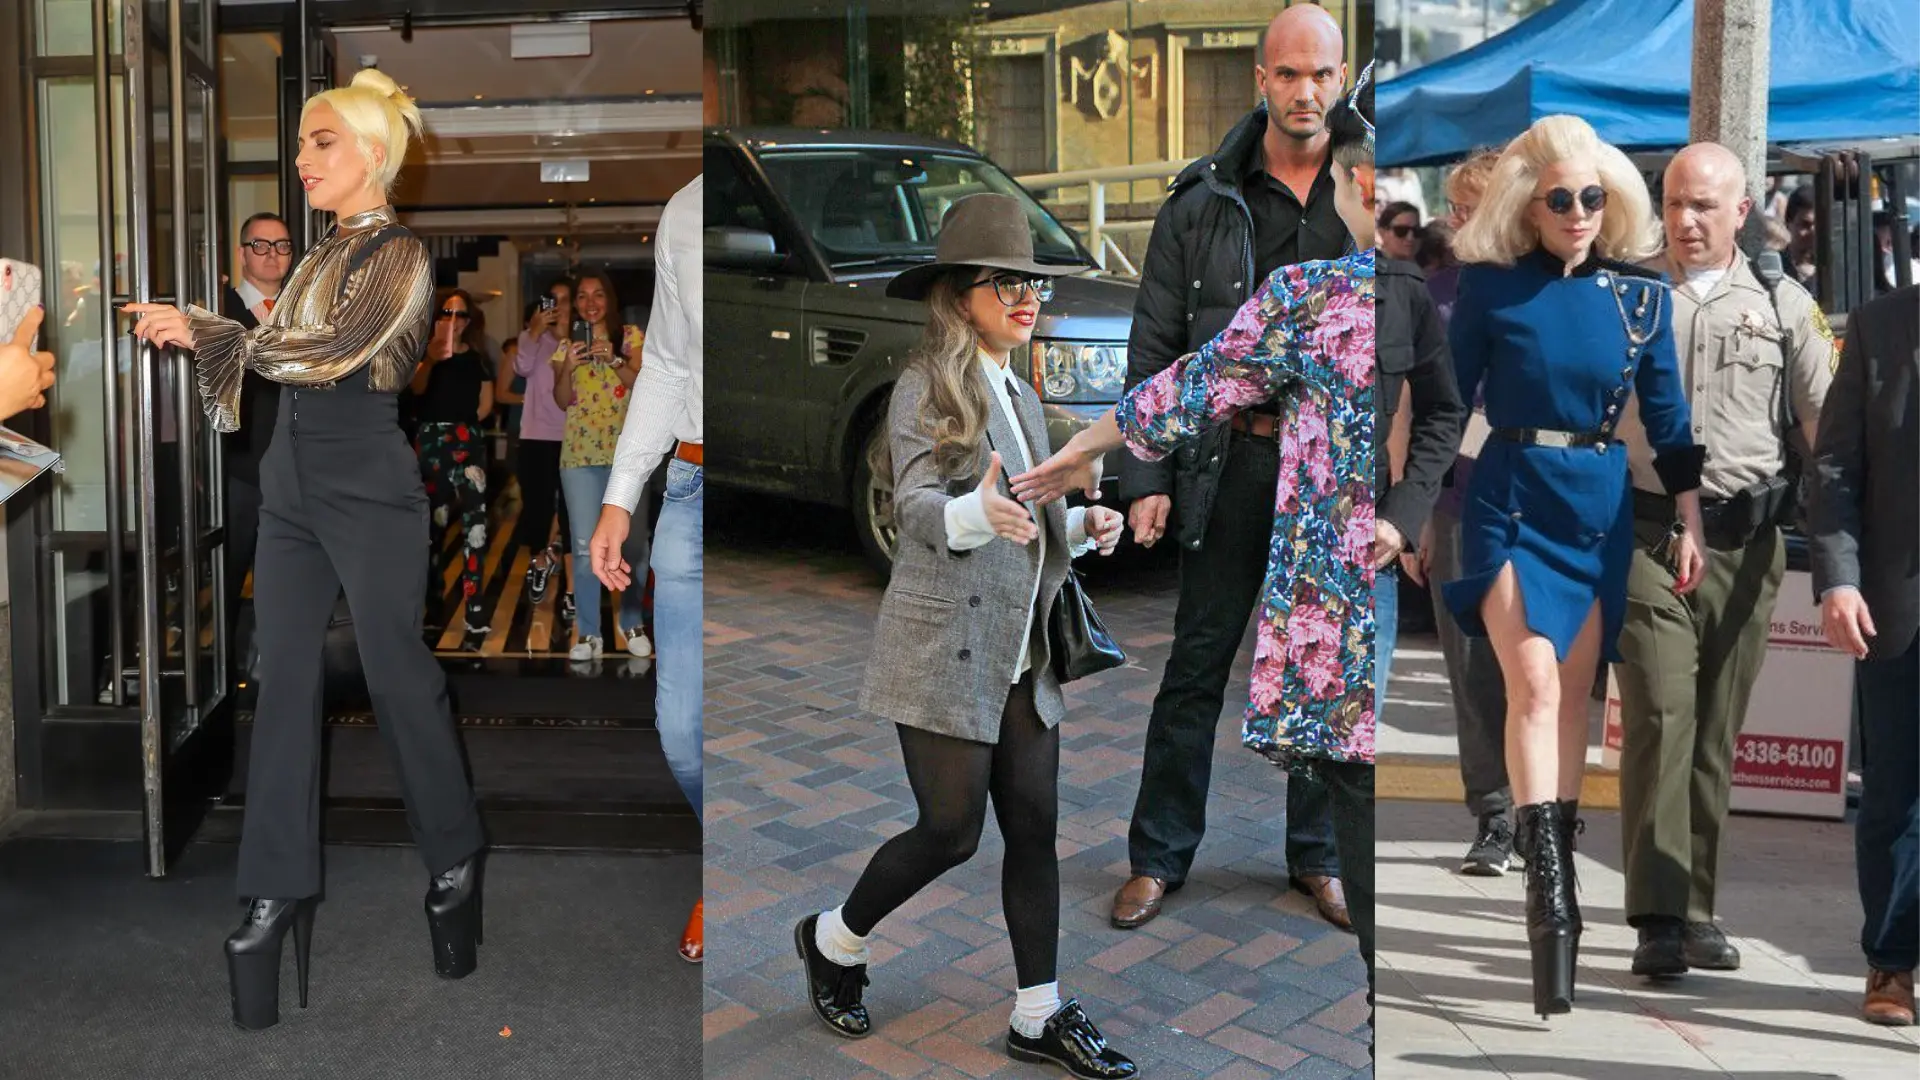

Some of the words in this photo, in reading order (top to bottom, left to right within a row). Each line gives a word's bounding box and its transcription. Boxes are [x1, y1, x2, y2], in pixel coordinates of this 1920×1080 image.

[1769, 621, 1786, 635] ns
[1789, 620, 1825, 637] Servi
[532, 718, 622, 727] MARK
